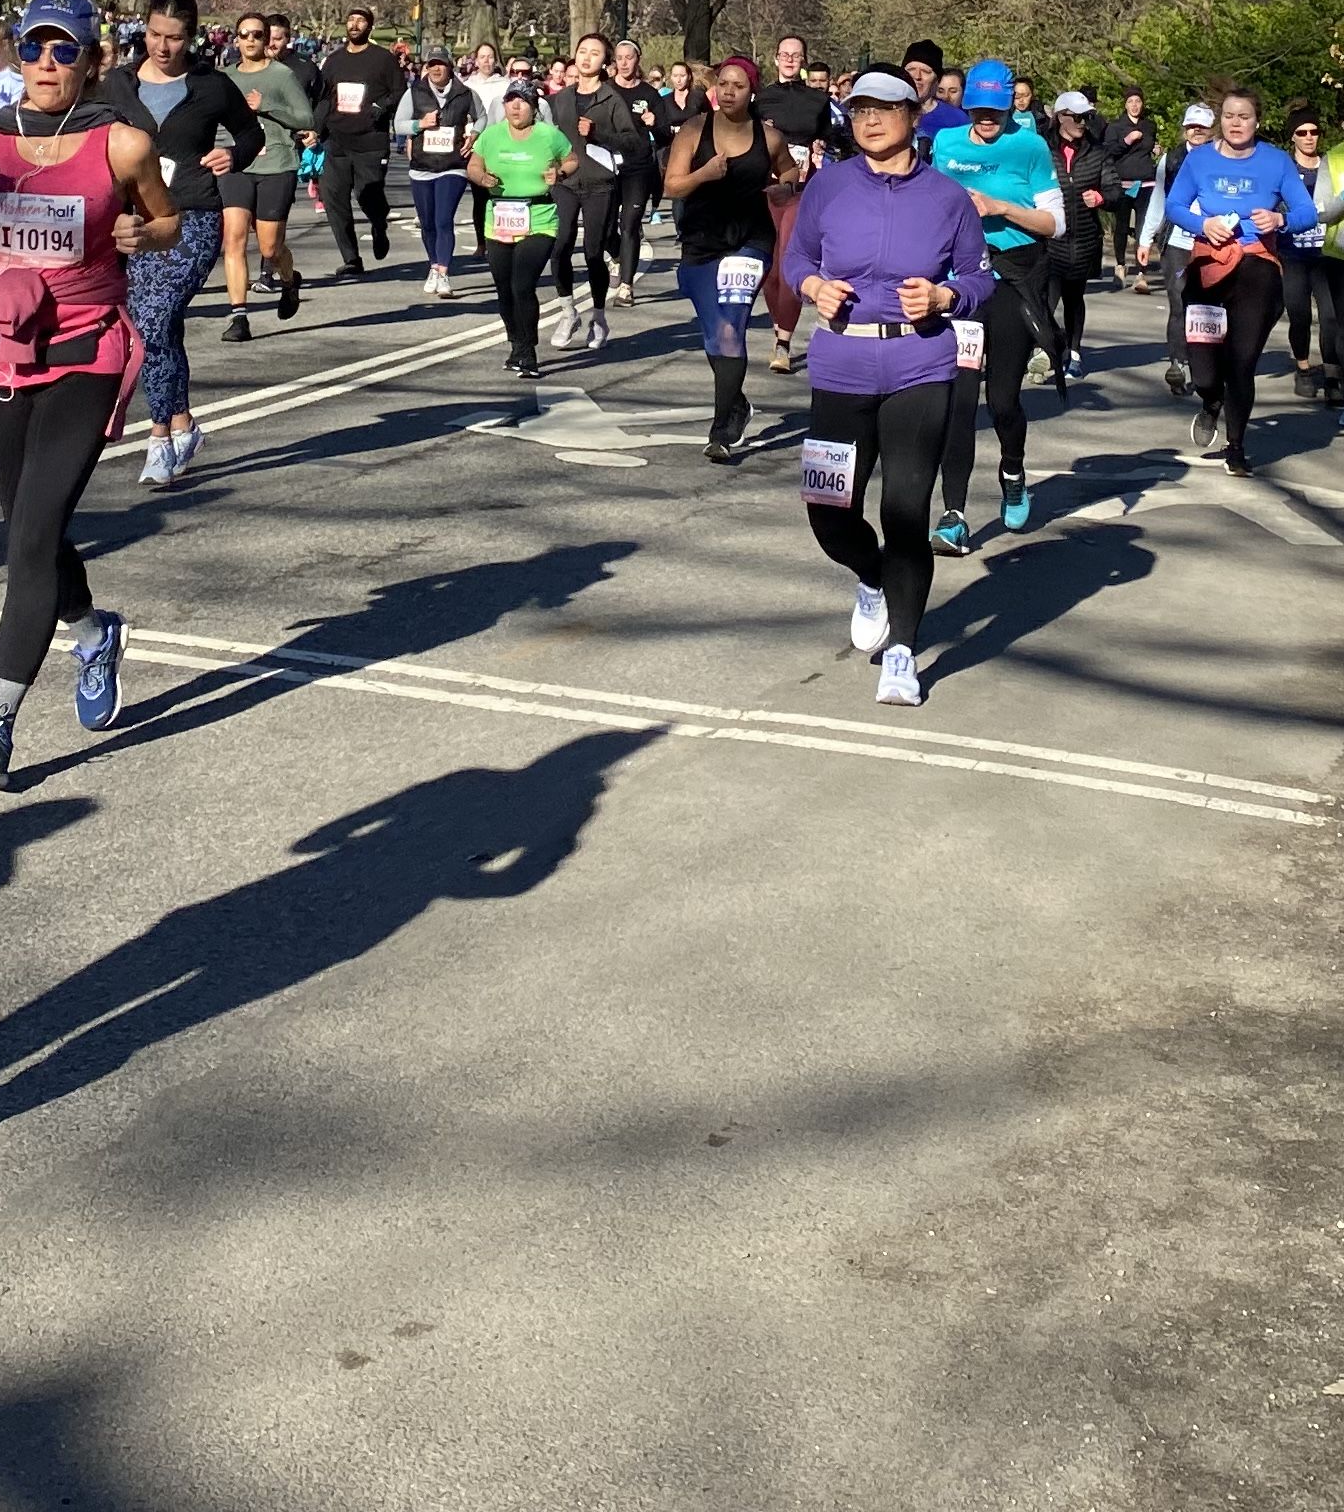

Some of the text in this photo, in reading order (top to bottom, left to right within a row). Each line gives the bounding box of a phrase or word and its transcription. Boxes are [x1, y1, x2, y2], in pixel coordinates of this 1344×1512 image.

[47, 204, 76, 218] half
[16, 228, 75, 252] 10194
[825, 450, 850, 463] half
[803, 469, 846, 492] 10046
